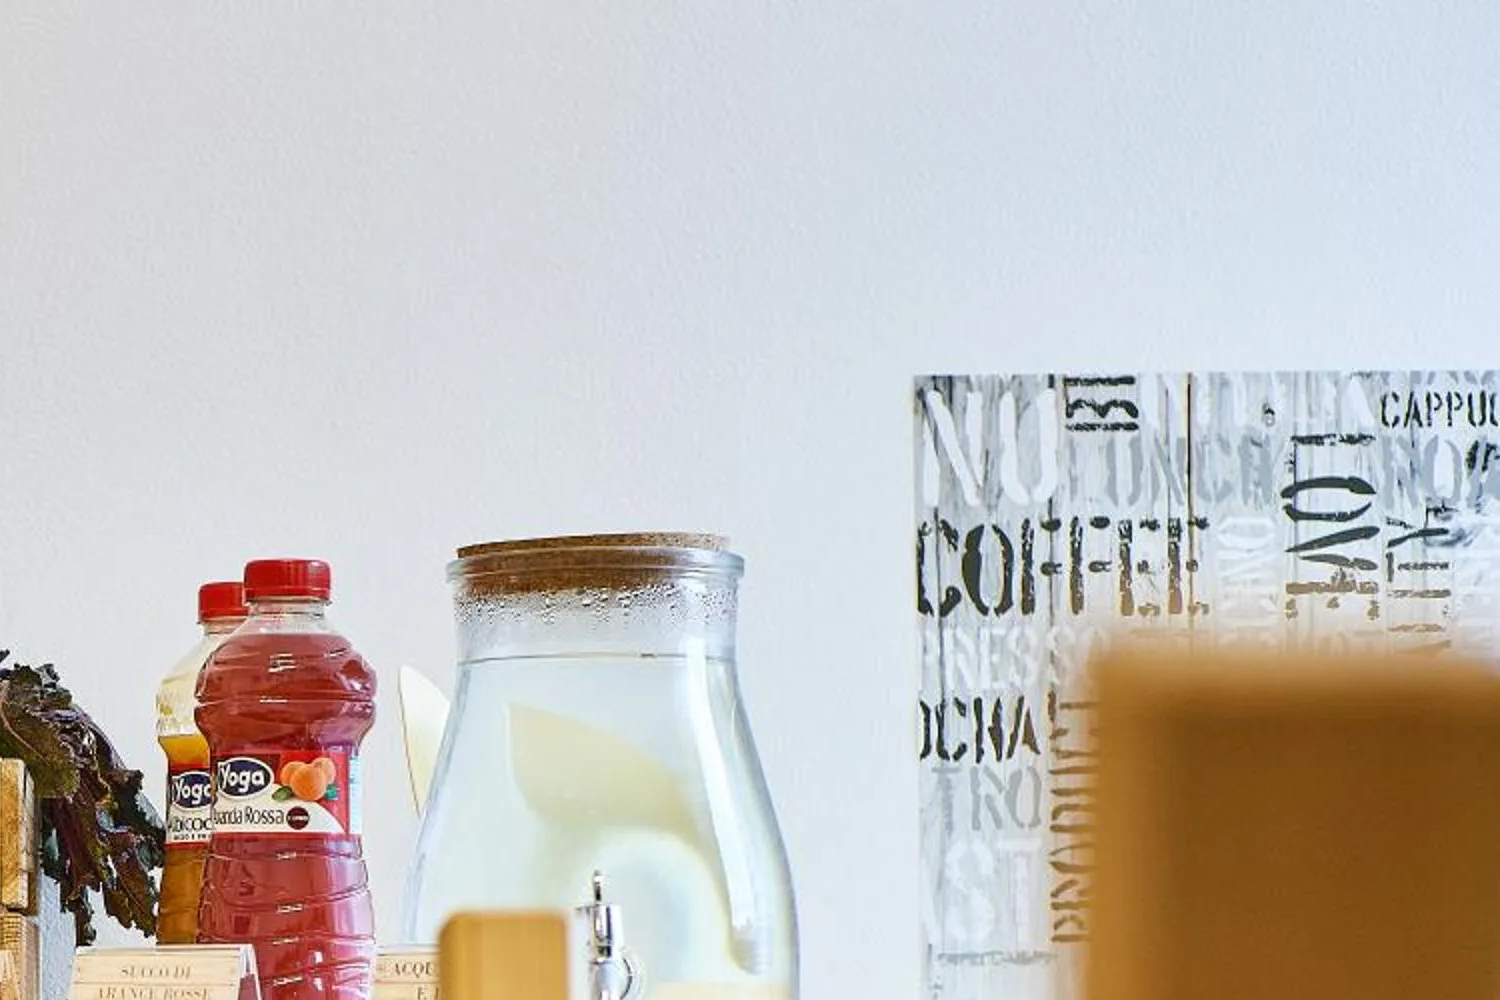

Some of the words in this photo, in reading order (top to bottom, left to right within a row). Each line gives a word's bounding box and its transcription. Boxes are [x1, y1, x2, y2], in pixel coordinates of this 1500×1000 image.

[1279, 432, 1382, 621] LOVE
[915, 515, 1212, 618] COFFEE
[220, 763, 265, 792] Yoga
[244, 804, 285, 825] Rossa
[121, 964, 169, 979] SUCCO
[174, 964, 191, 979] DI
[394, 961, 436, 978] ACQU
